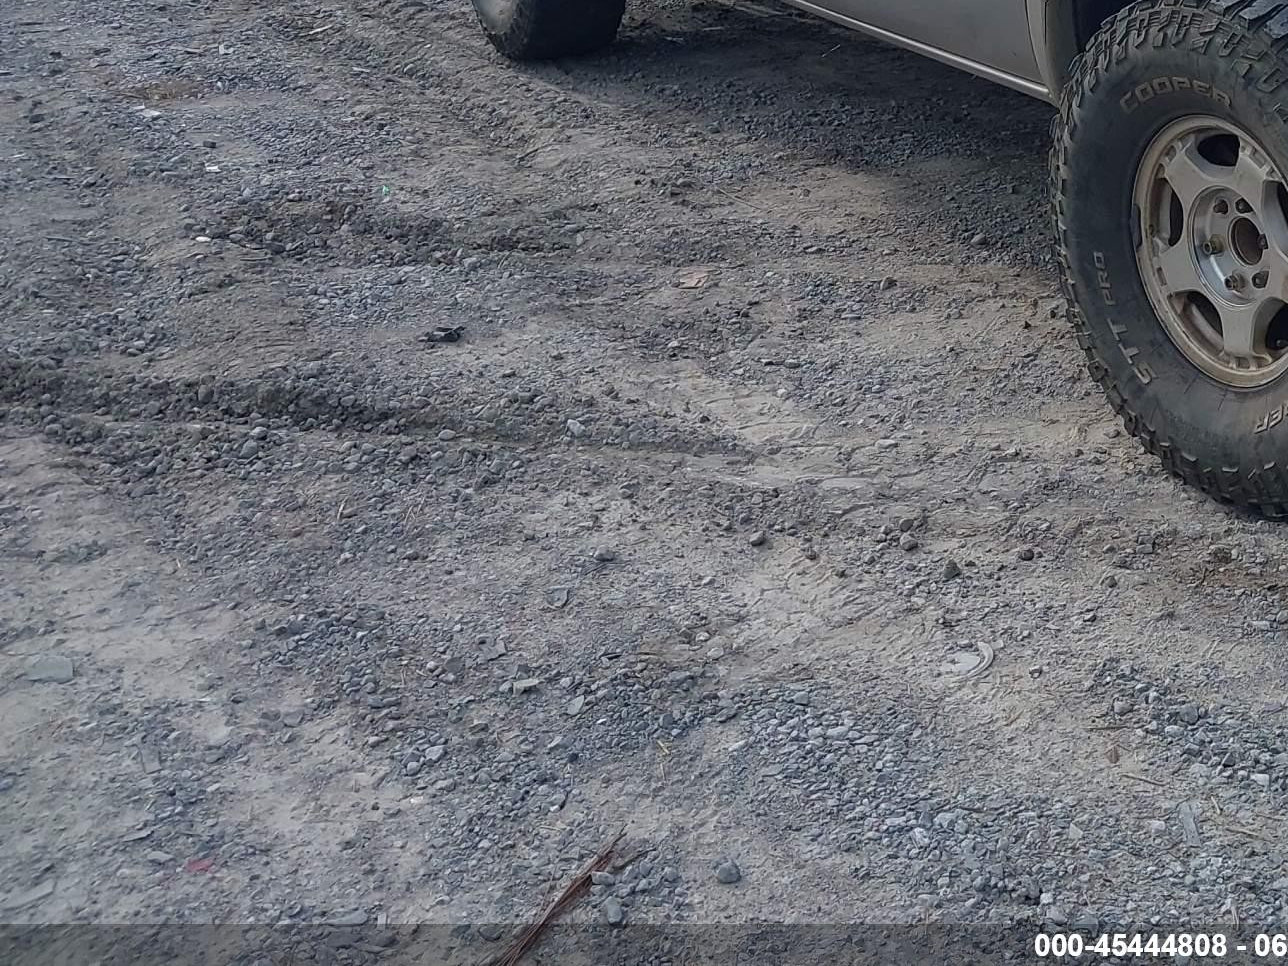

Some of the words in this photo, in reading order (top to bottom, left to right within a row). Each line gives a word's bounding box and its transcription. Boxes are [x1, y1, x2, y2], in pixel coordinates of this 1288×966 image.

[1119, 76, 1233, 114] COOPER
[1094, 250, 1117, 306] PRO
[1107, 317, 1158, 385] STT
